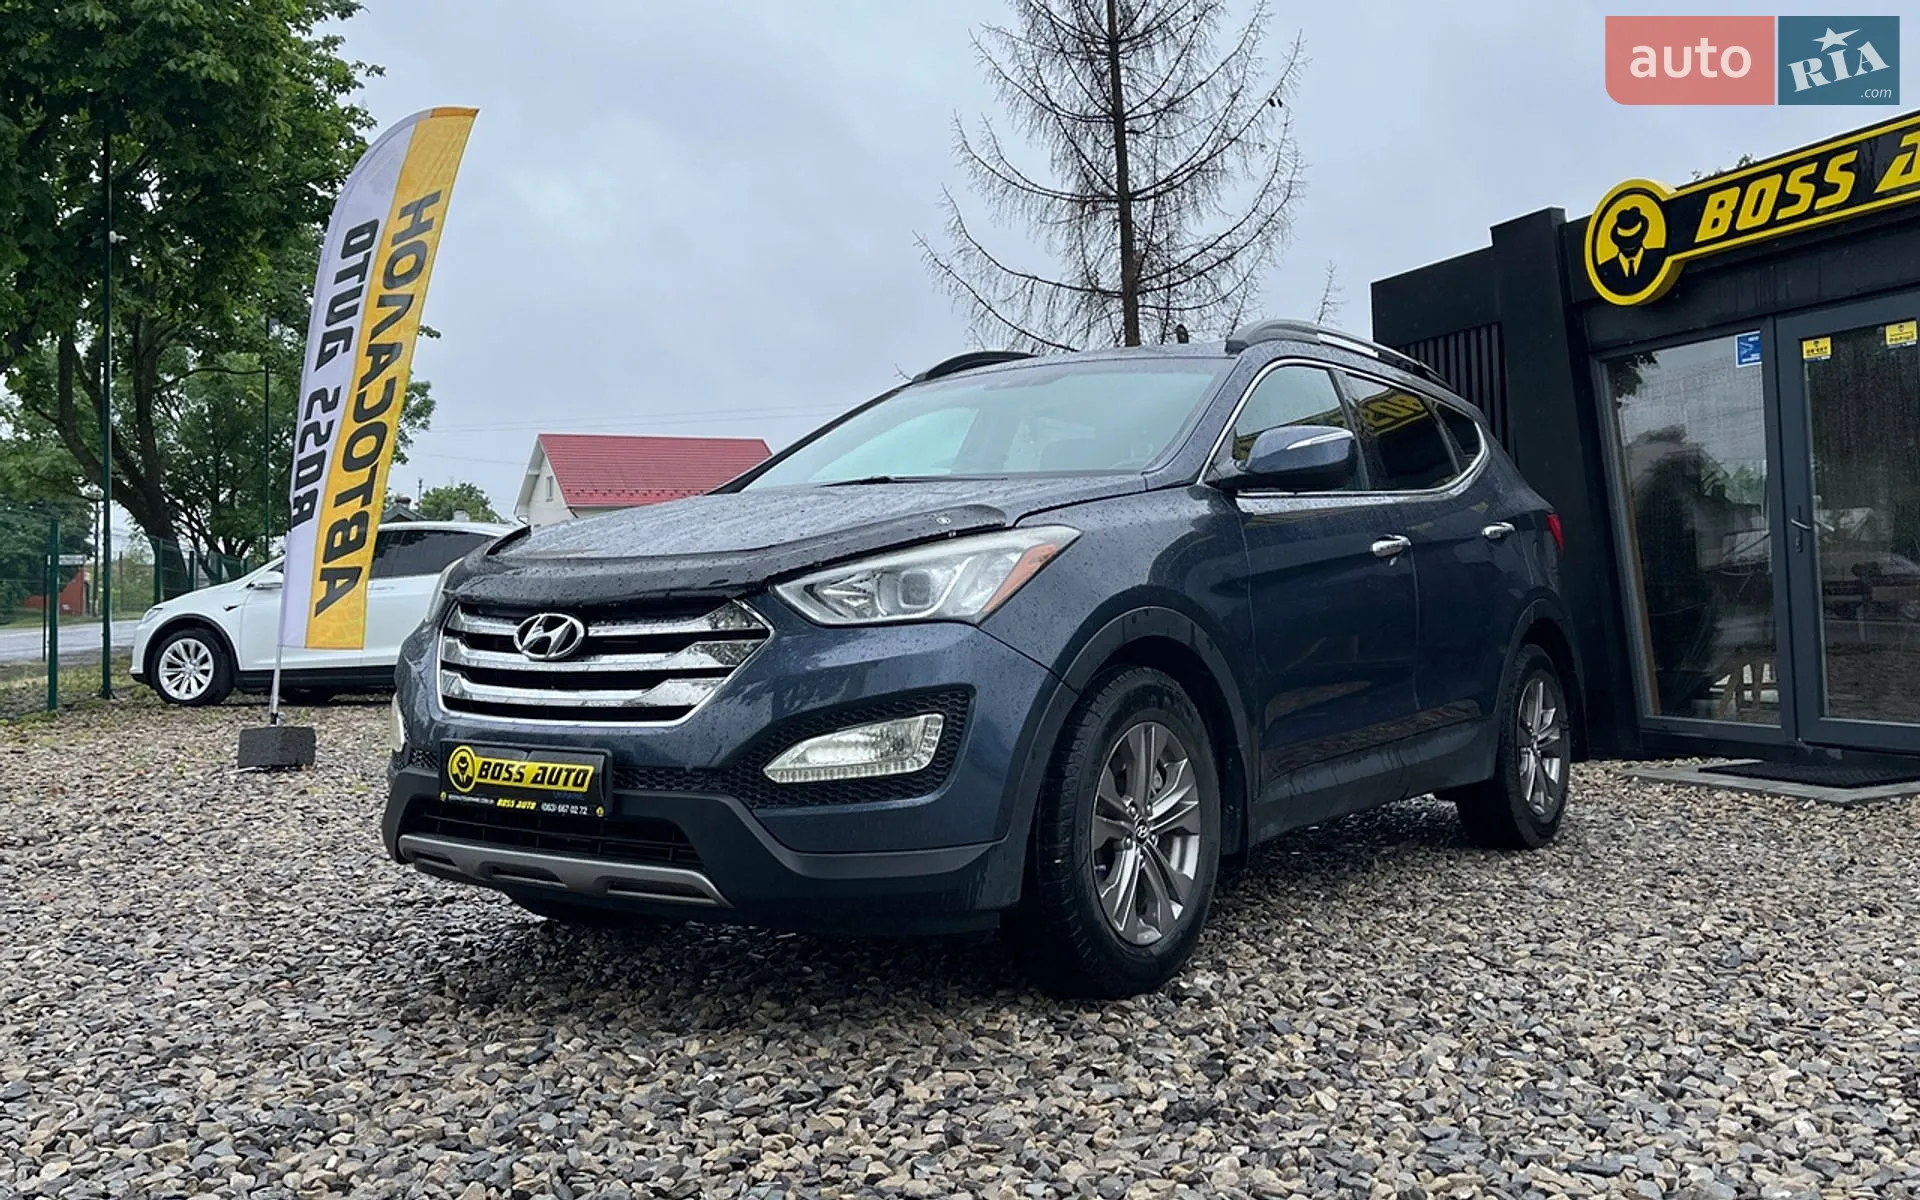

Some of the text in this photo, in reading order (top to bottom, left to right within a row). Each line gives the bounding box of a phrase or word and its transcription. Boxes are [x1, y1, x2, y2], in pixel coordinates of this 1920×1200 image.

[1695, 150, 1858, 243] BOSS
[477, 761, 590, 788] BOSS AUTO
